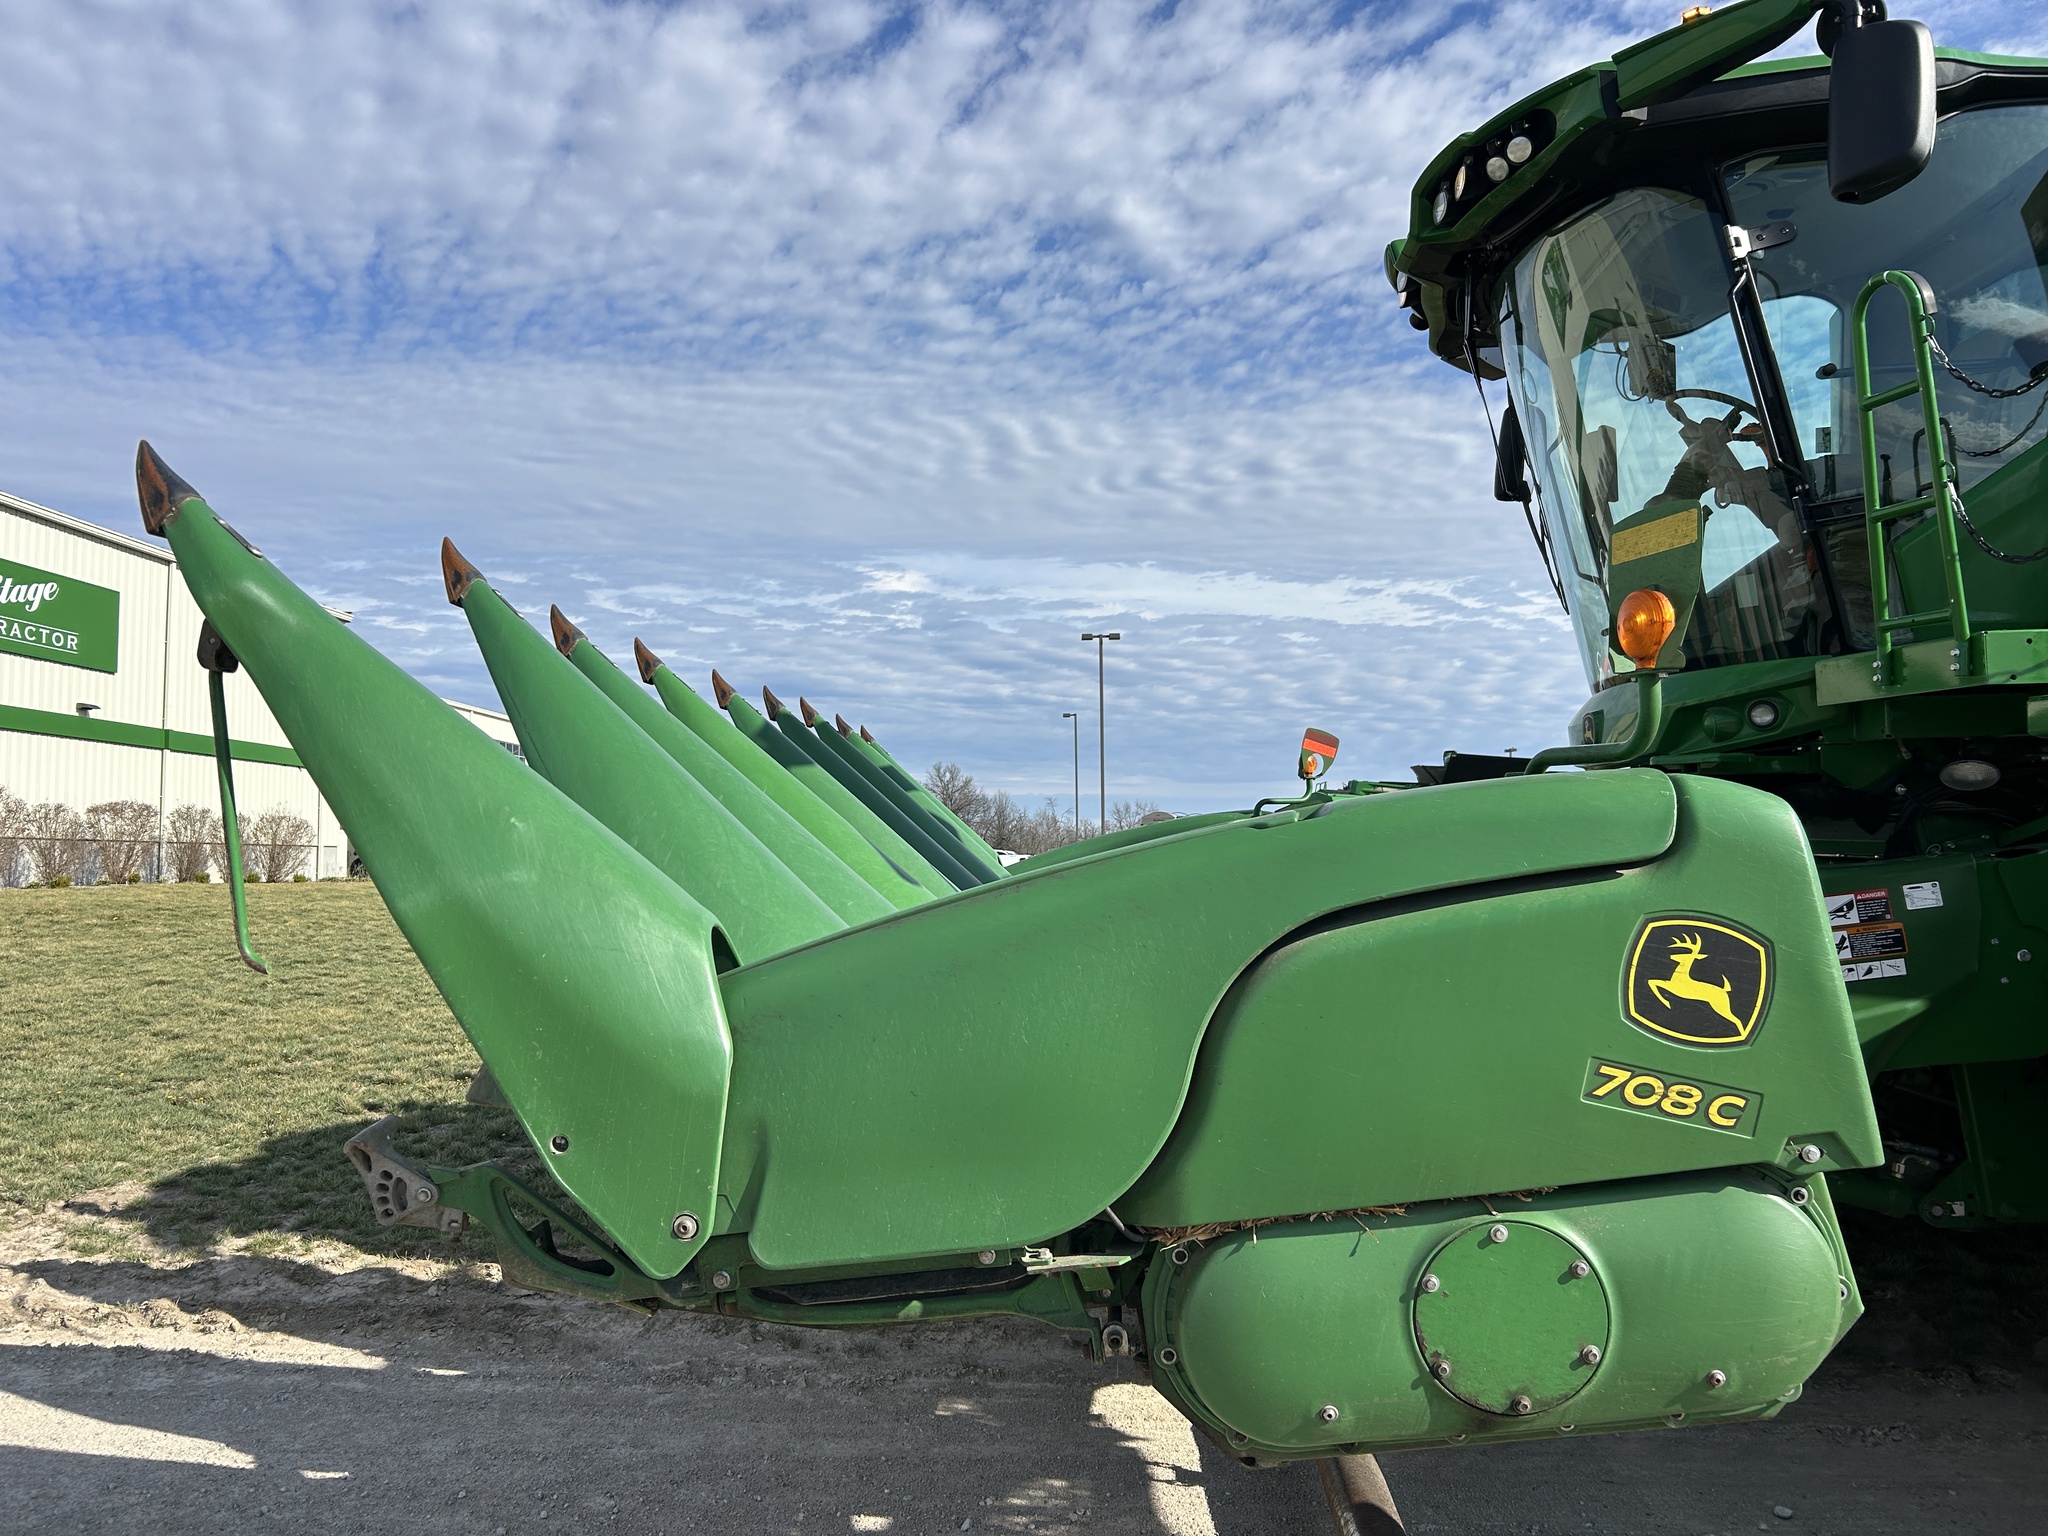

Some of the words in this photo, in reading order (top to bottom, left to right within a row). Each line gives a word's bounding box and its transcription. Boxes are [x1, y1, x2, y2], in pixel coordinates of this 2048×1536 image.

[0, 575, 60, 612] tage
[1586, 1064, 1704, 1118] 708
[1705, 1094, 1750, 1129] C
